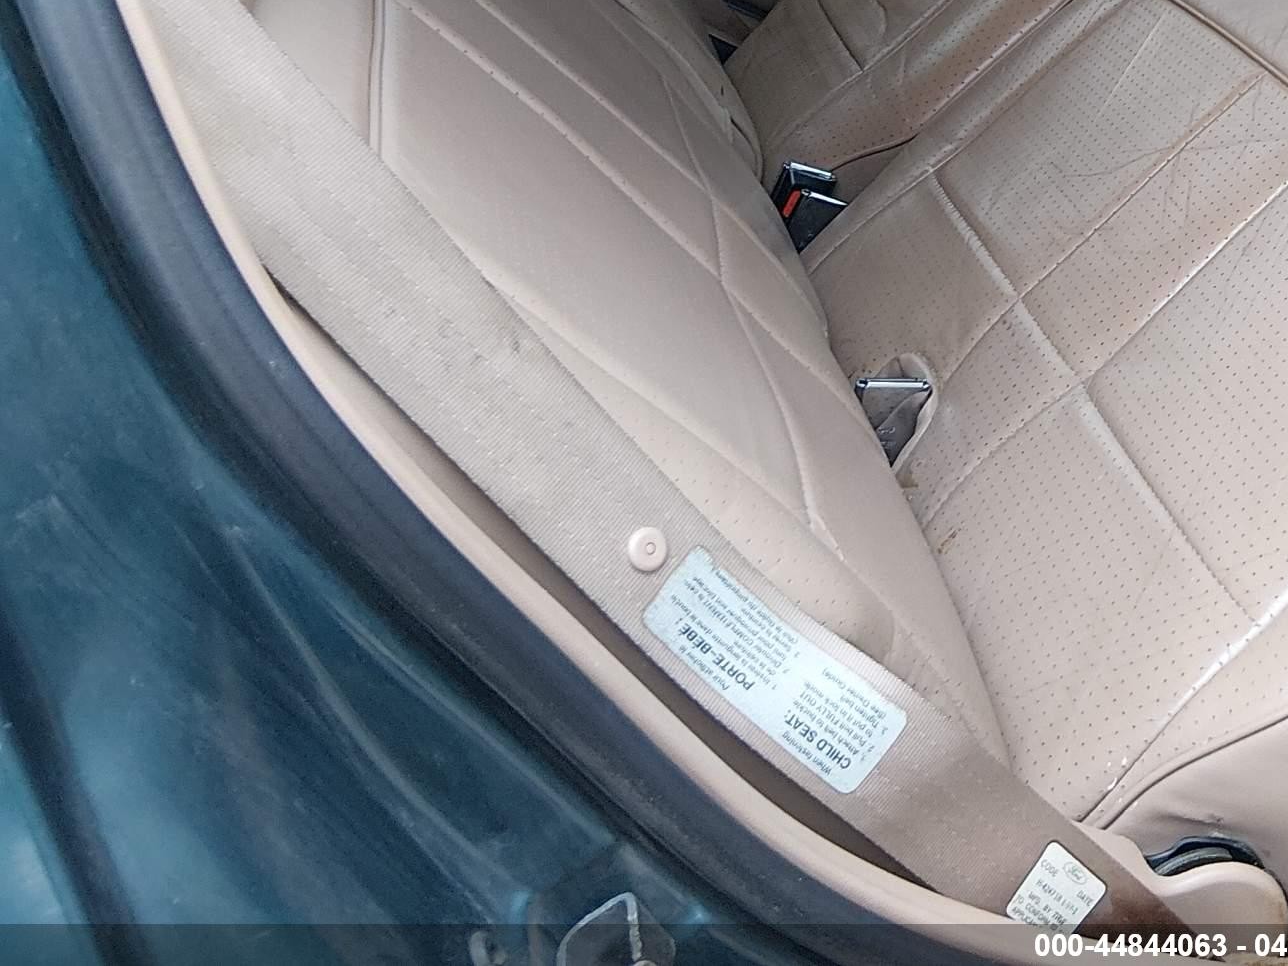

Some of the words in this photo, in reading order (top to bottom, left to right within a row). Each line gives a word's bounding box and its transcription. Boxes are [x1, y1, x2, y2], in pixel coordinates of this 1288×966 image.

[799, 690, 817, 706] OUT
[815, 718, 824, 727] to
[816, 703, 839, 725] FULLY
[781, 709, 818, 743] SEAT:
[823, 724, 838, 738] belt
[781, 730, 813, 759] fastening
[815, 736, 851, 770] CHILD
[837, 735, 859, 755] Attach
[812, 756, 831, 774] When
